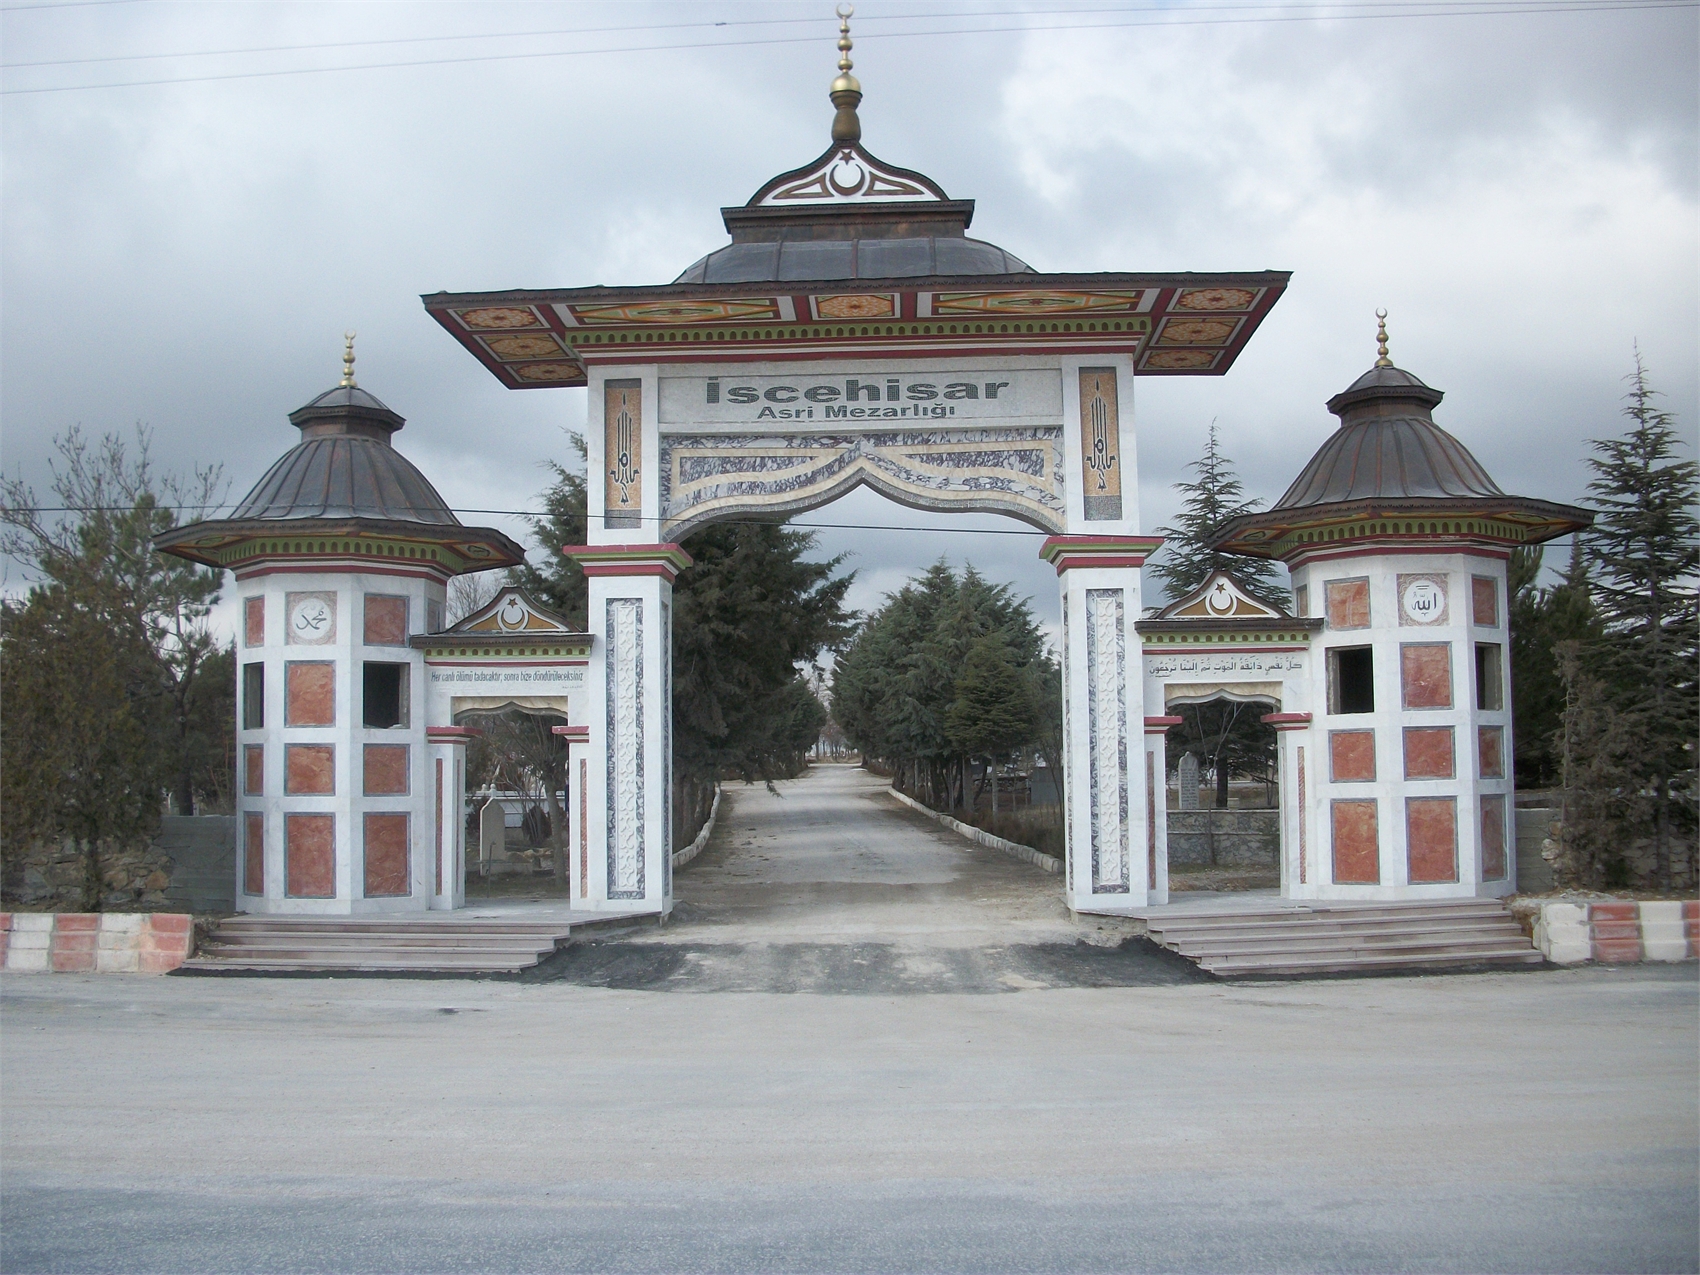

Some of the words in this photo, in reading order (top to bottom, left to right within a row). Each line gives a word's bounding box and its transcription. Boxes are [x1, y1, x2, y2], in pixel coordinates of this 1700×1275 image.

[706, 376, 1010, 404] İscehisar
[757, 405, 813, 419] Asri
[825, 402, 956, 419] Mezarlığı
[431, 671, 441, 682] Her
[442, 671, 454, 682] canlı
[456, 670, 474, 682] ölümü
[504, 672, 519, 682] sonra
[520, 670, 532, 682] bize
